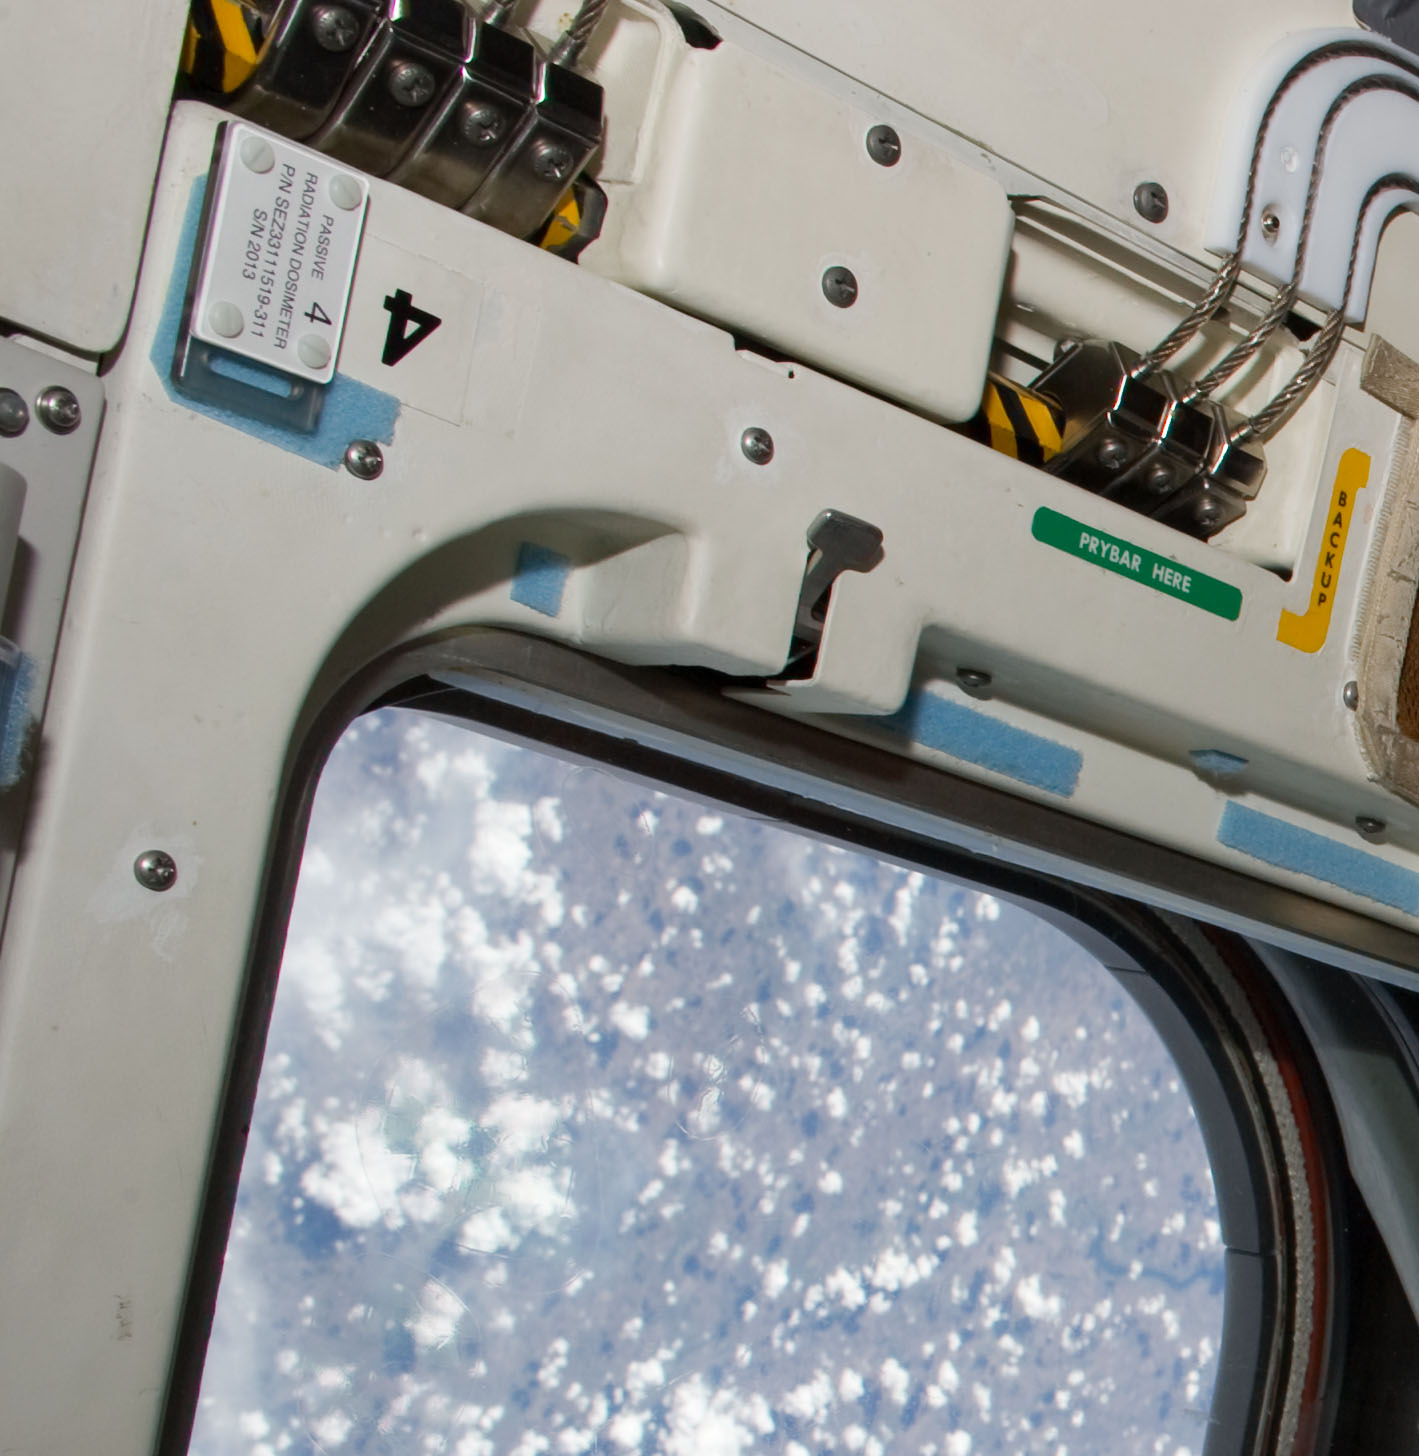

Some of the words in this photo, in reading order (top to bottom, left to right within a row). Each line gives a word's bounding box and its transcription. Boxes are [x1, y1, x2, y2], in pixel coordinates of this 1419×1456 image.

[278, 163, 296, 195] P/N
[249, 207, 268, 238] S/N
[291, 171, 319, 260] RADIATION
[311, 214, 335, 281] PASSIVE
[241, 239, 262, 281] 2013
[273, 257, 303, 350] DOSIMETER
[304, 301, 333, 327] 4
[381, 287, 443, 367] 4
[1078, 531, 1142, 573] PRYBAR
[1151, 562, 1193, 594] HERE
[1316, 490, 1349, 608] BACKUP
